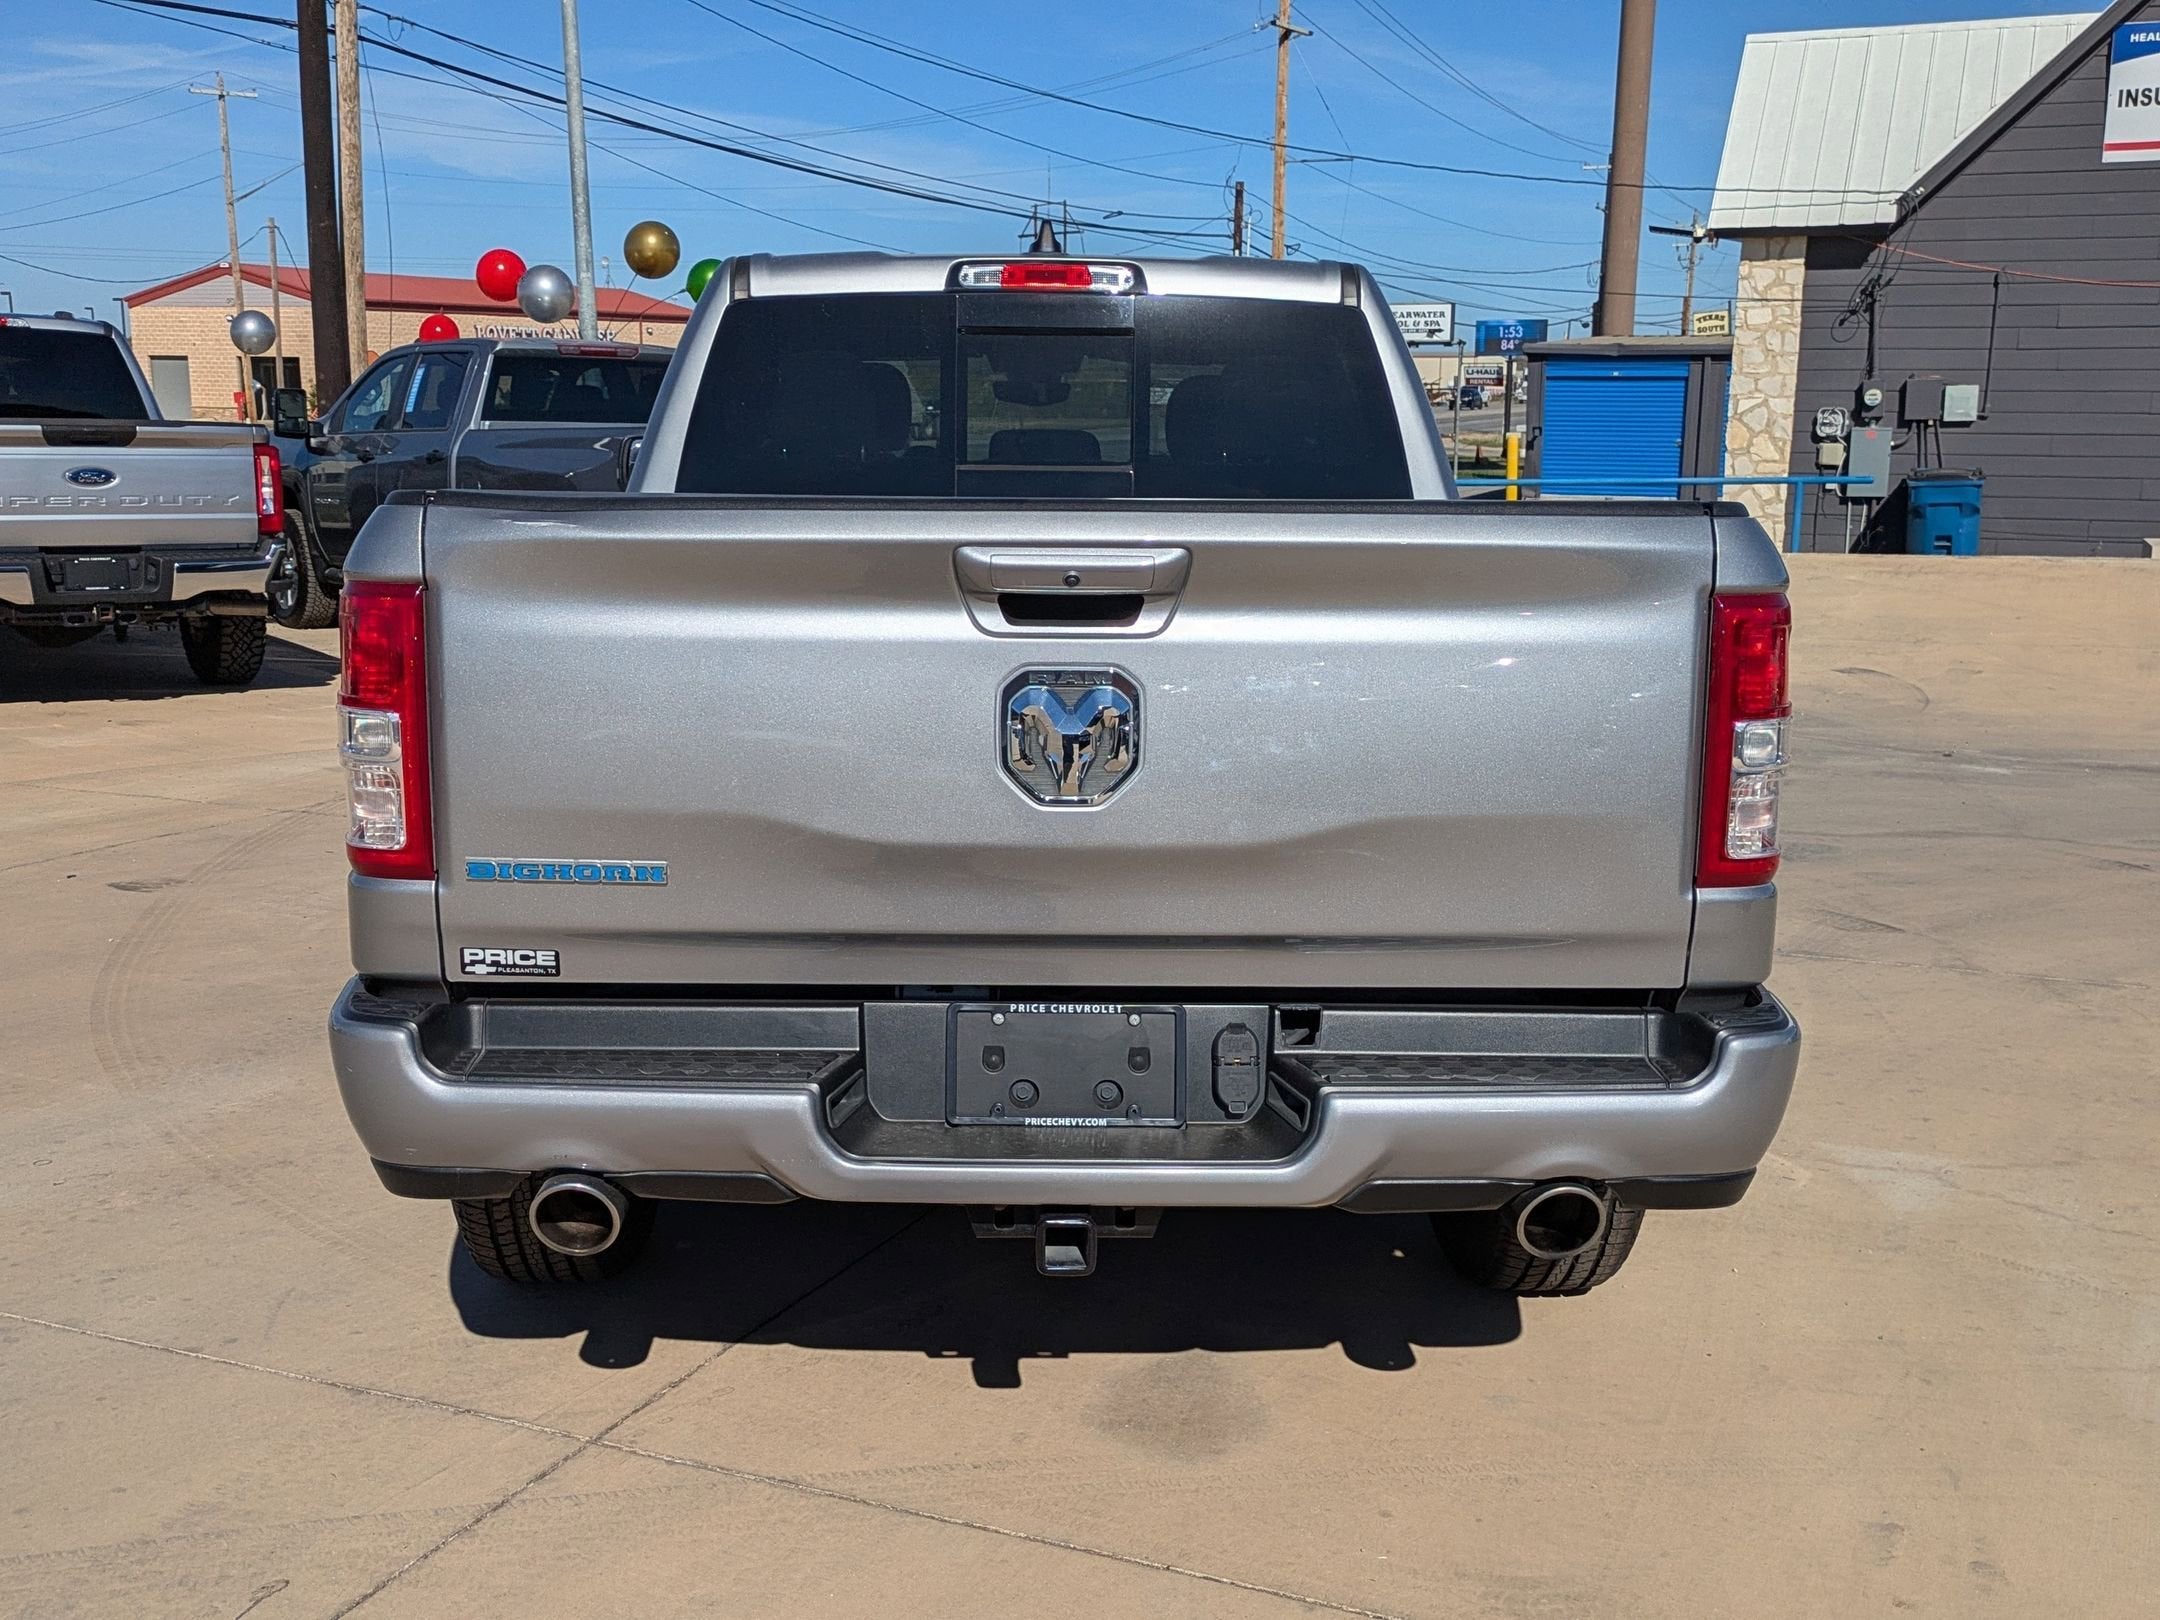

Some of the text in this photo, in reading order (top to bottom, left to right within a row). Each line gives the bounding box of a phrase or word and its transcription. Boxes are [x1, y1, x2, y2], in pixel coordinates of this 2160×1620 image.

[1423, 320, 1441, 328] SPA
[1697, 325, 1725, 333] SOUTH
[1499, 326, 1523, 338] 1:53
[0, 495, 240, 508] PER DUTY
[463, 948, 557, 966] PRICE
[1010, 1003, 1122, 1013] PRICE CHEVROLET
[1024, 1117, 1107, 1127] PRICECHEVY.COM
